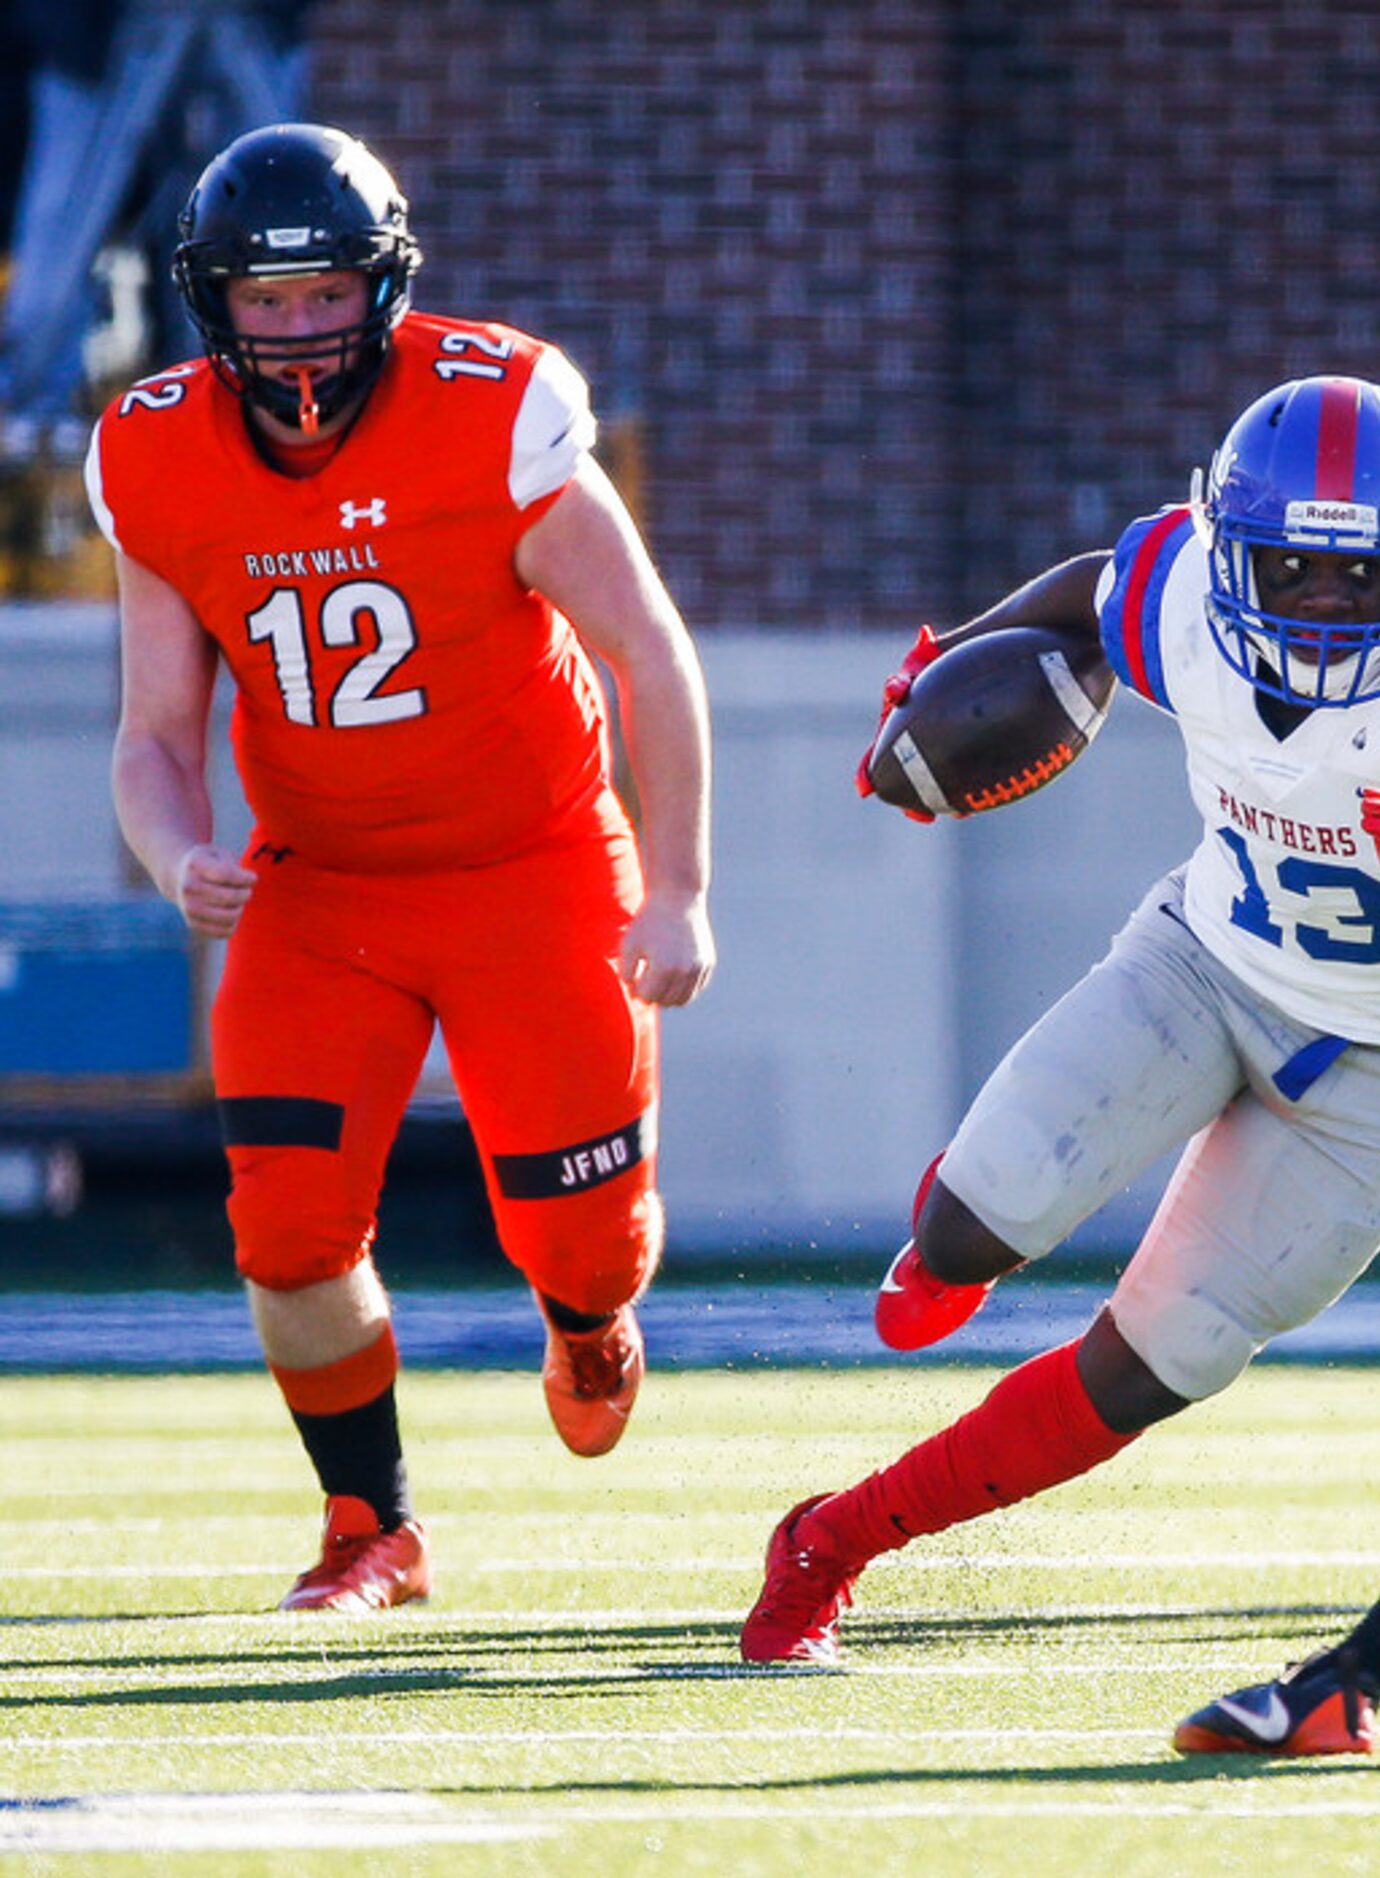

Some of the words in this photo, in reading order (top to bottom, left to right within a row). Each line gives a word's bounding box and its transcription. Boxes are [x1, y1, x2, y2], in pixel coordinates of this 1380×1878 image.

[432, 331, 515, 383] 12
[245, 543, 380, 577] ROCKWALL
[245, 578, 430, 728] 12
[1216, 785, 1358, 858] PANTHERS
[561, 1136, 628, 1187] JFND
